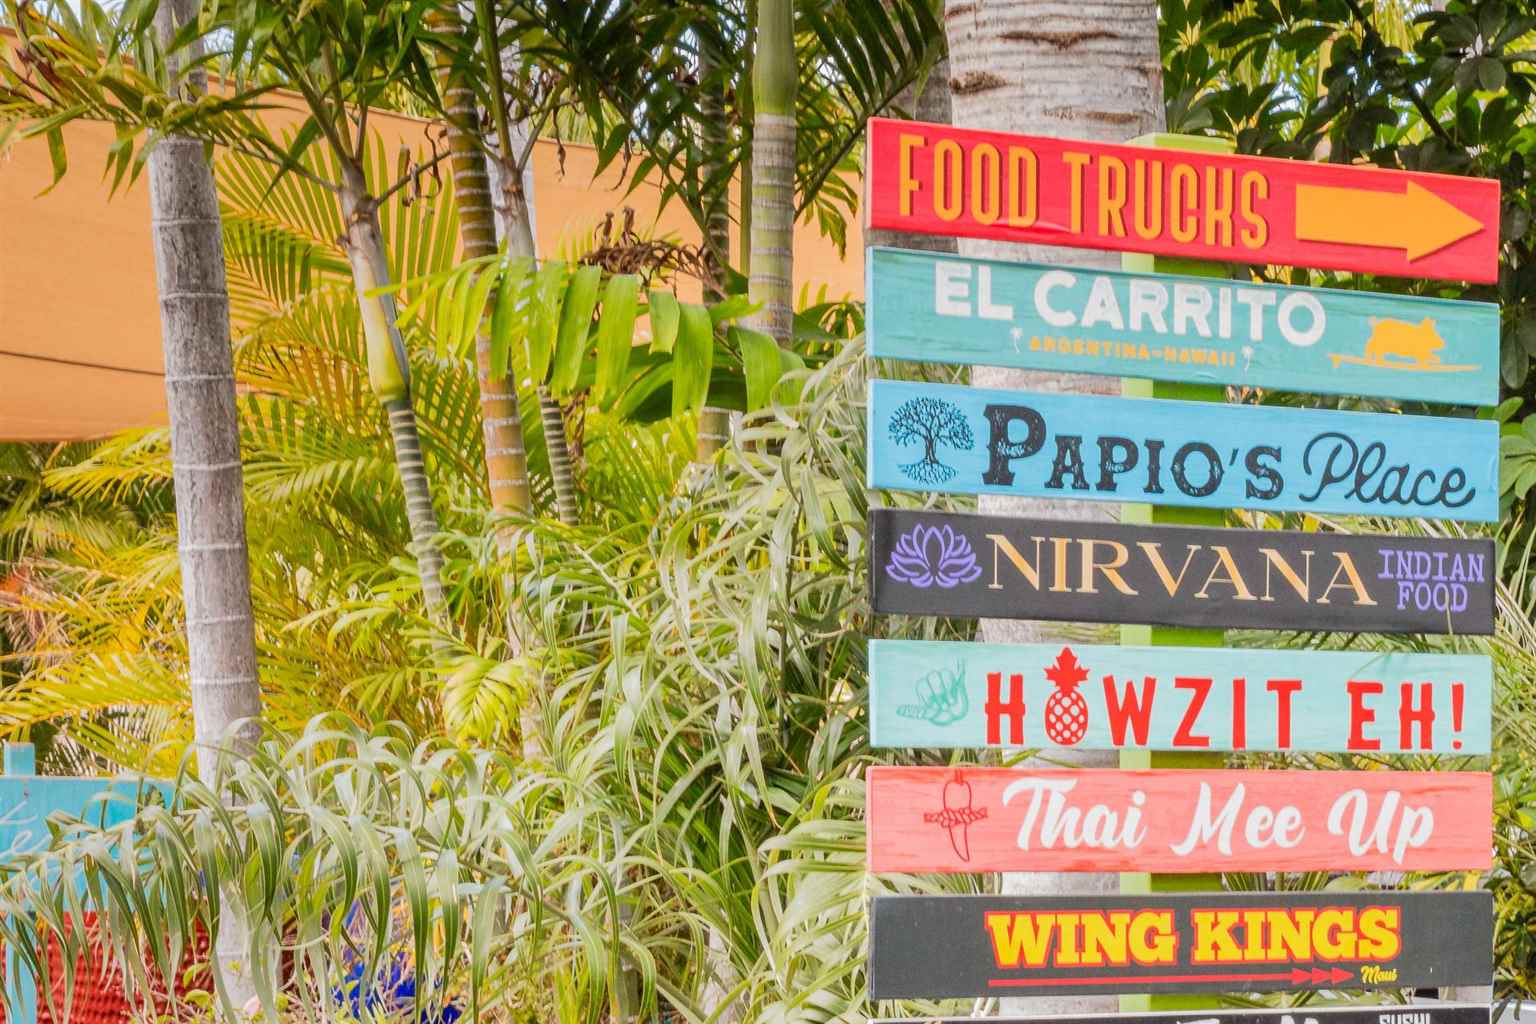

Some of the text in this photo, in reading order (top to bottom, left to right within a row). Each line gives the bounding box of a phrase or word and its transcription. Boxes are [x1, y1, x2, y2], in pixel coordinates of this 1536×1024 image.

[900, 134, 1271, 250] FOOD TRUCKS
[935, 263, 1326, 347] EL CARRITO
[1299, 432, 1476, 508] Place
[985, 533, 1378, 606] NIRVANA
[1378, 549, 1484, 582] INDIAN
[1397, 581, 1468, 612] FOOD
[1347, 680, 1465, 750] EH!
[1002, 778, 1435, 865] Thai Mee Up
[985, 906, 1402, 969] WING KINGS
[1361, 965, 1398, 984] Maui
